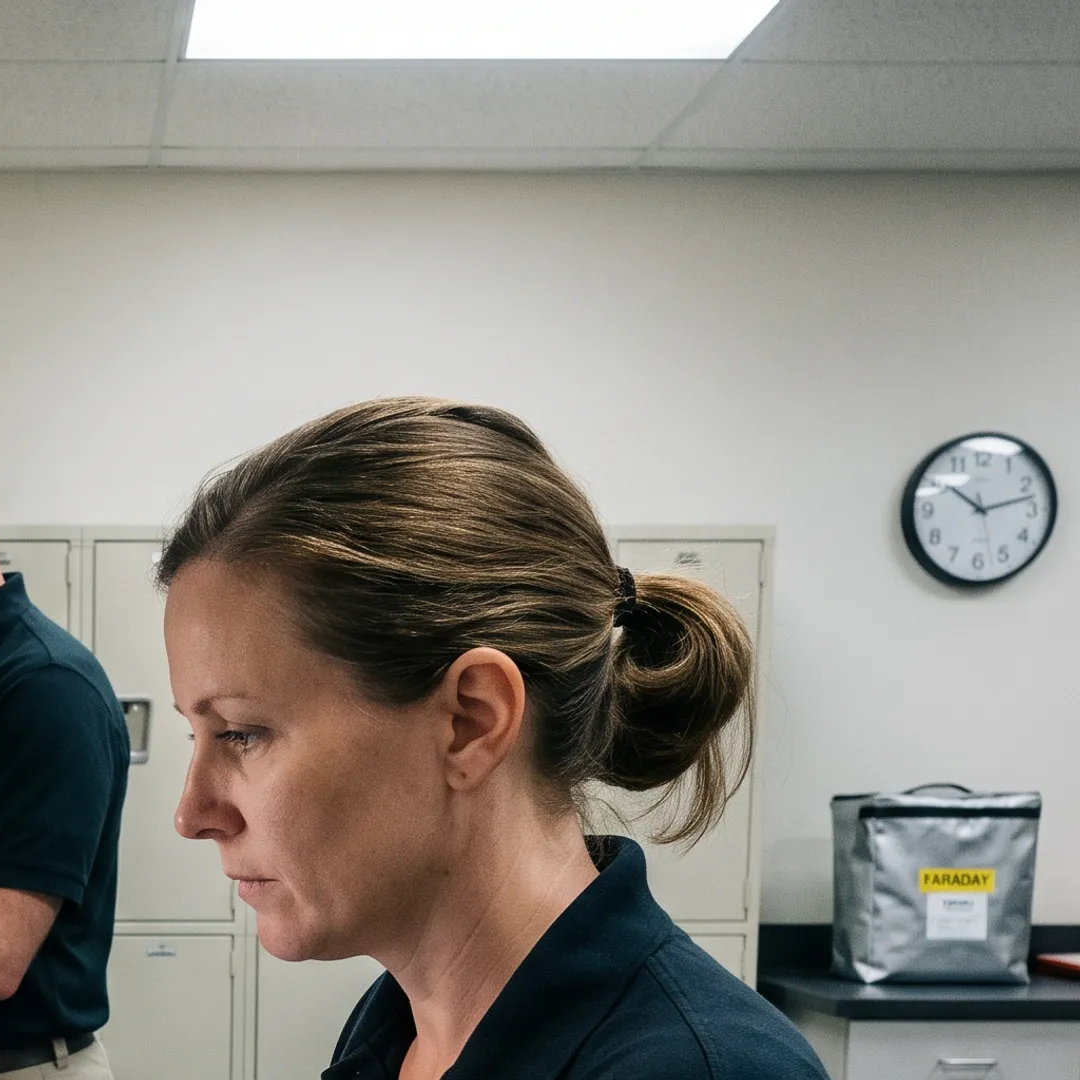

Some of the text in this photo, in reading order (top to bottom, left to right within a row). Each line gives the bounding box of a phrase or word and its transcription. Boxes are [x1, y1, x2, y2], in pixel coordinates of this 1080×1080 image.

[950, 456, 966, 472] 11
[1020, 476, 1031, 492] 2
[921, 501, 934, 518] 9
[1026, 502, 1038, 518] 3
[929, 528, 941, 545] 8
[1017, 528, 1029, 543] 4
[948, 546, 960, 563] 7
[972, 552, 985, 570] 6
[997, 546, 1009, 563] 5
[923, 873, 989, 887] FARADAY
